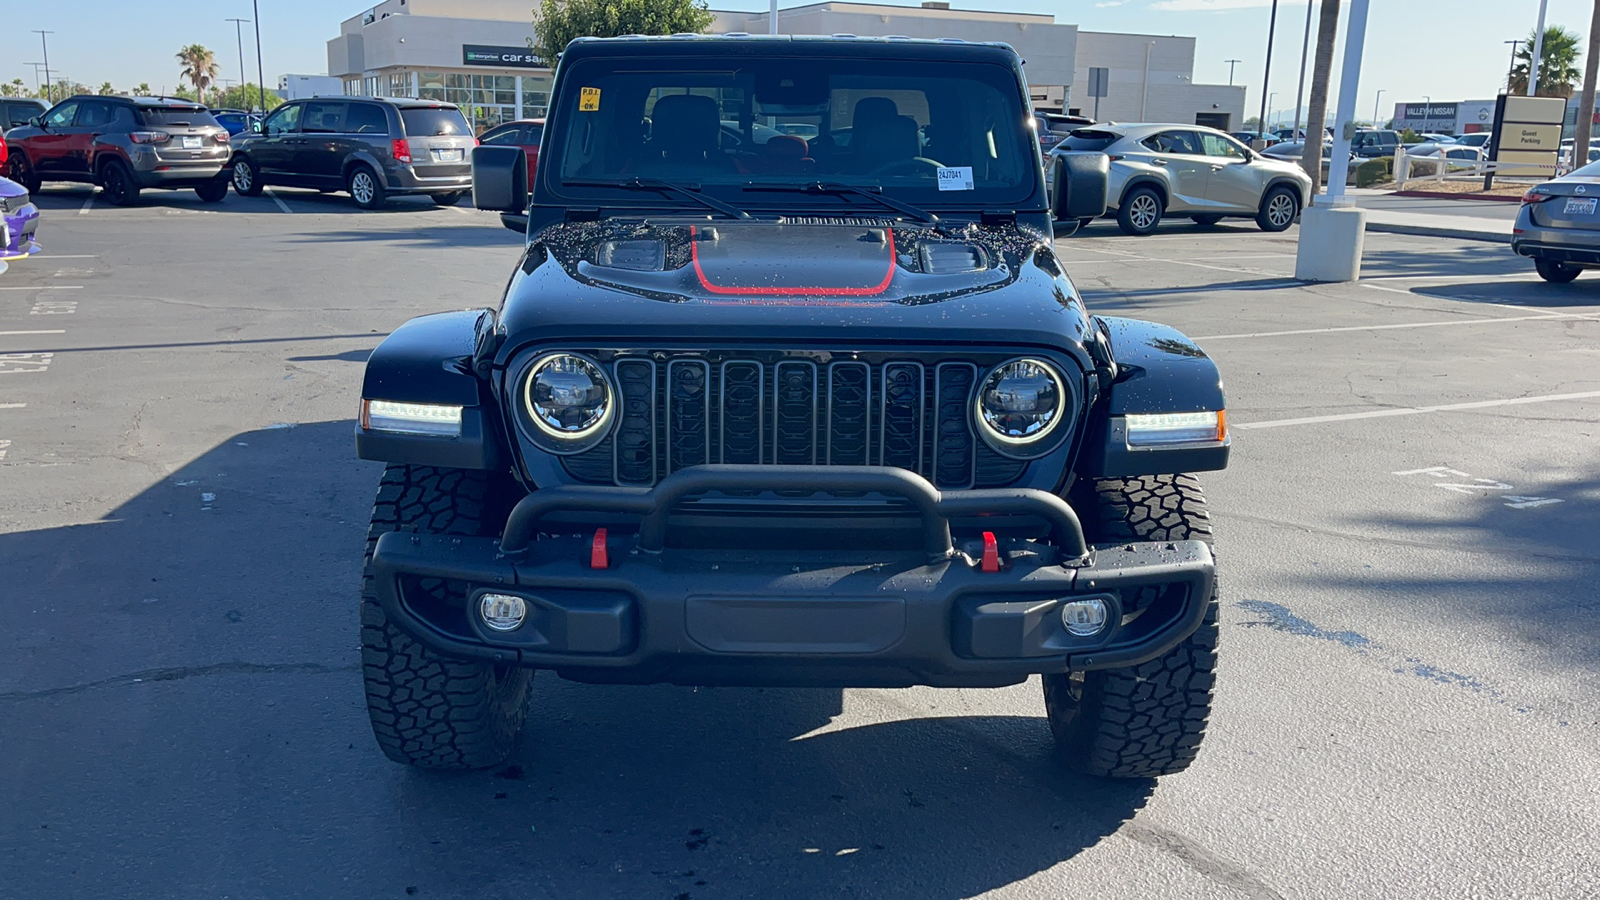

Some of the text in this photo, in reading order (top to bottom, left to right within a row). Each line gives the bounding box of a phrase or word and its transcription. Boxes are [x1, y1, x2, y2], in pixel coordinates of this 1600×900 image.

[502, 54, 522, 62] car
[1406, 107, 1426, 115] VALLEY
[1434, 107, 1455, 115] NISSAN
[1520, 137, 1541, 145] Parking
[938, 171, 961, 179] 24J7041
